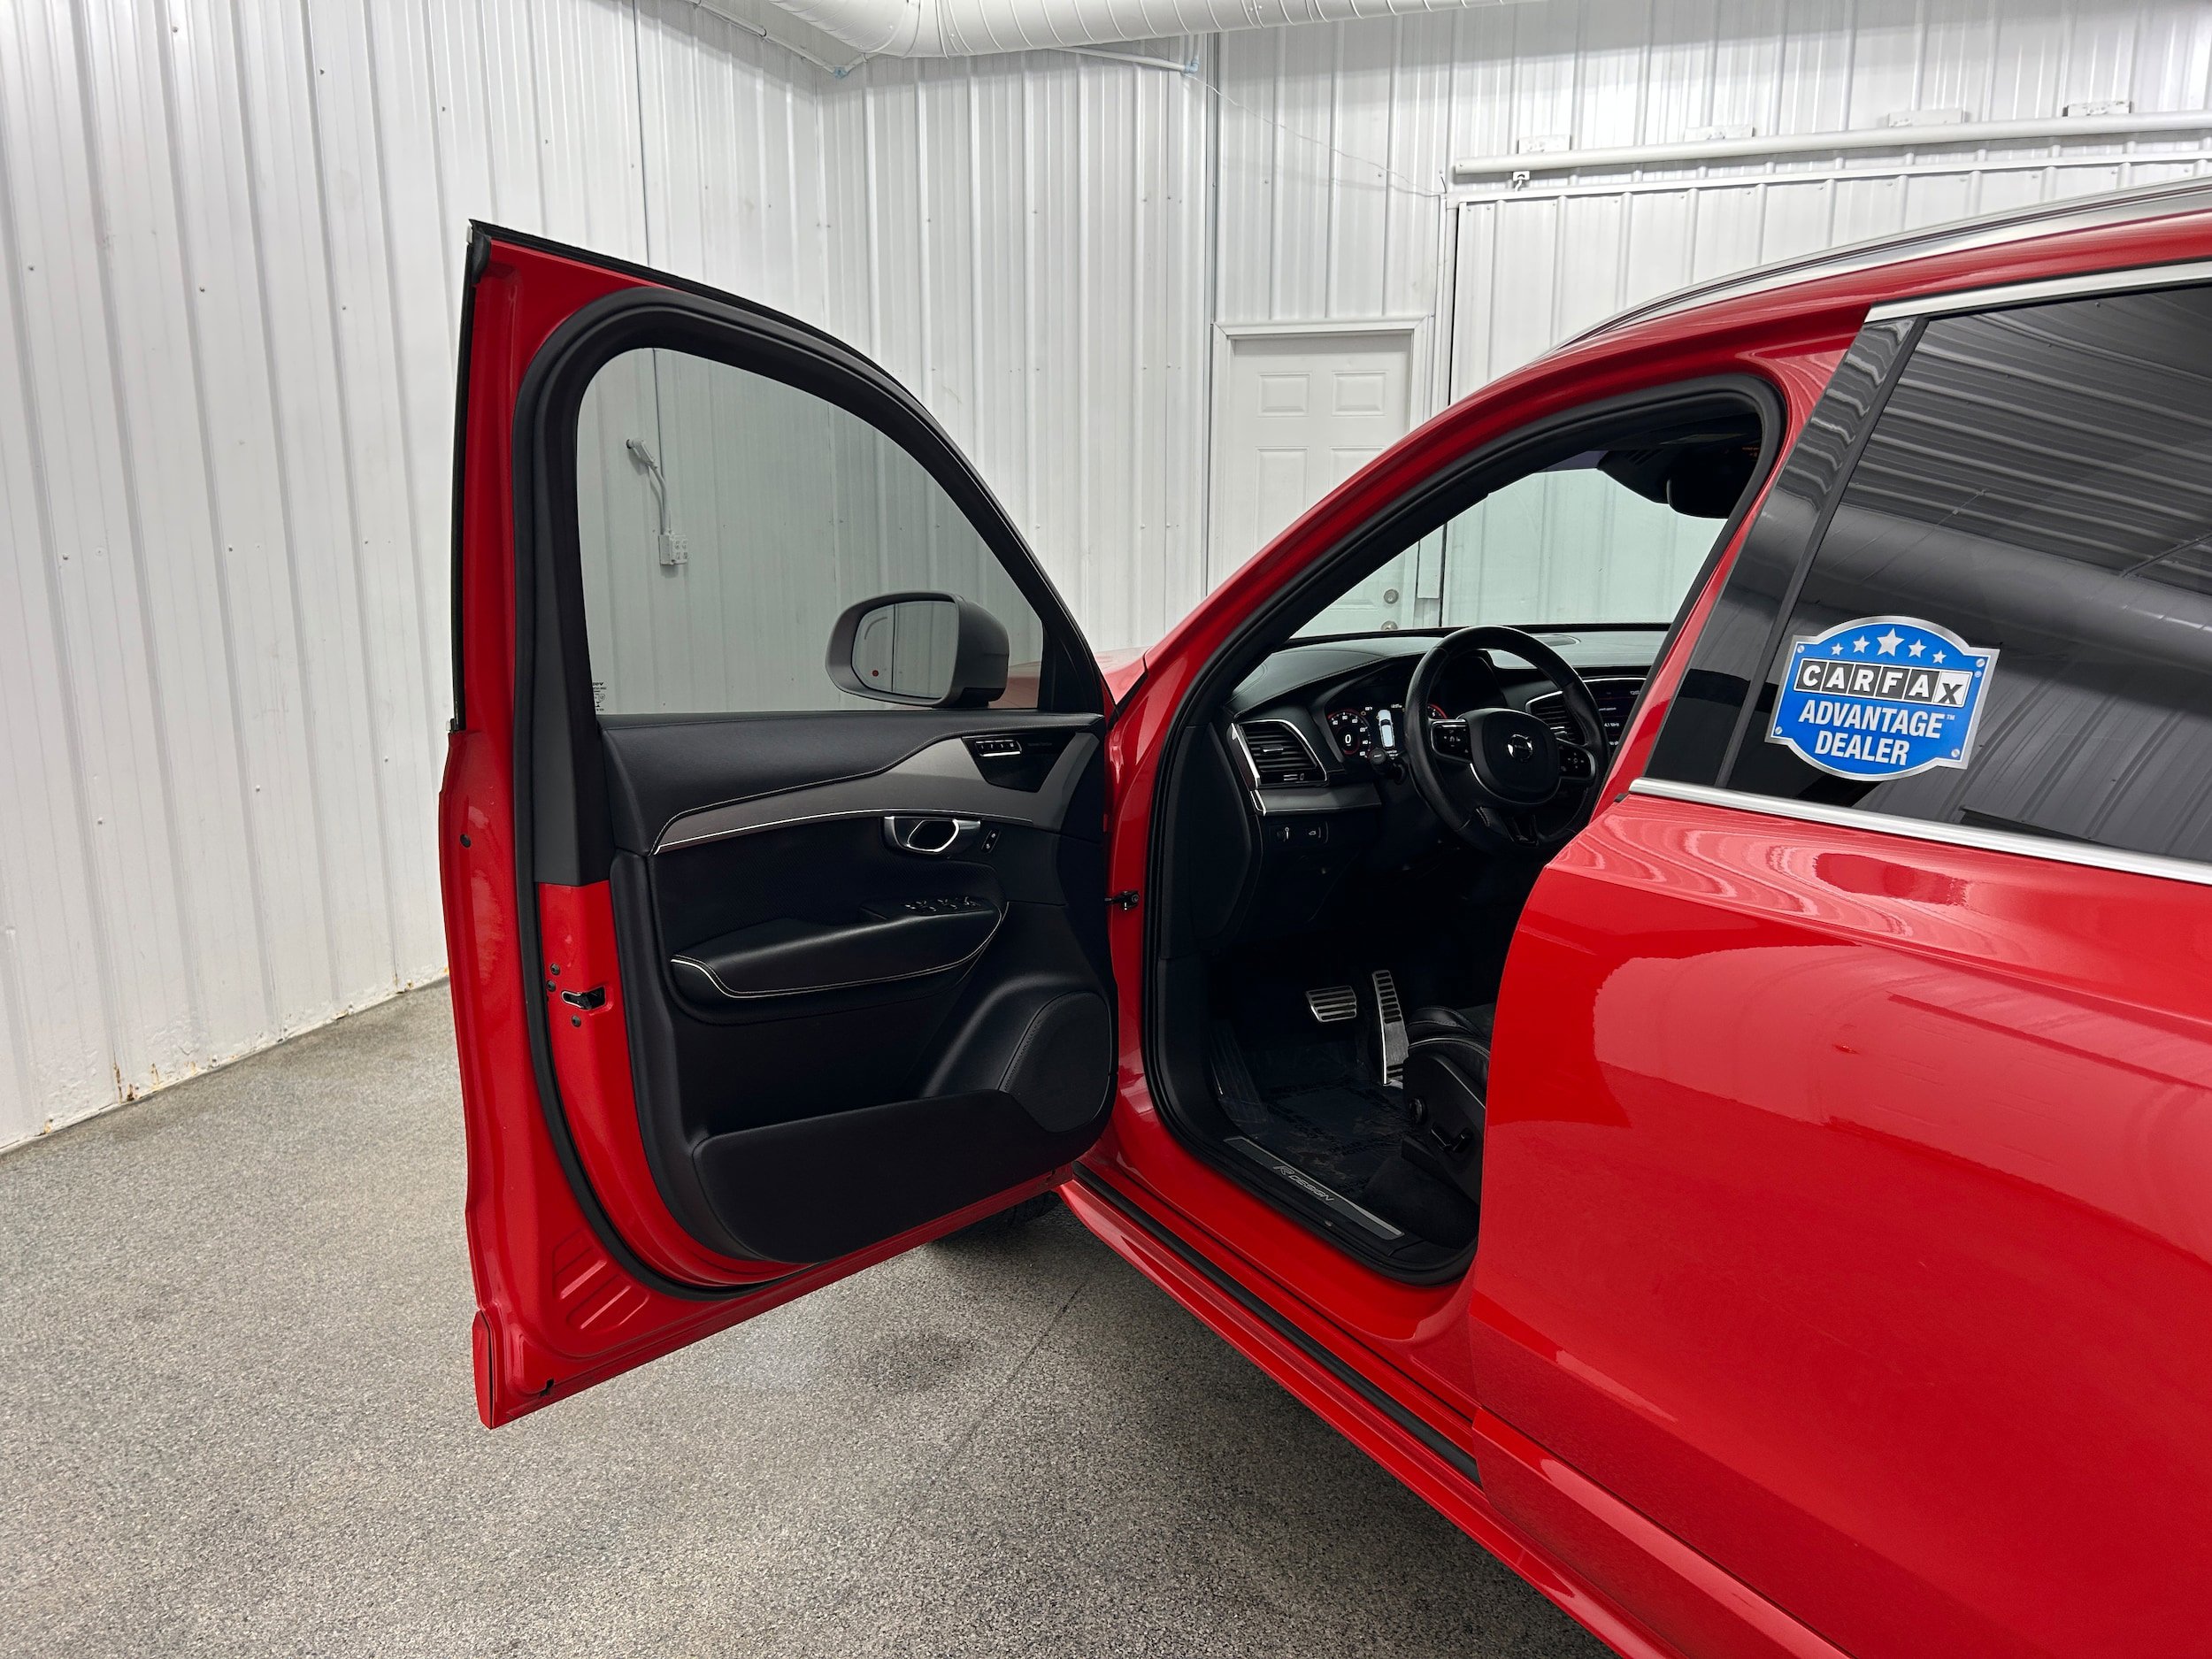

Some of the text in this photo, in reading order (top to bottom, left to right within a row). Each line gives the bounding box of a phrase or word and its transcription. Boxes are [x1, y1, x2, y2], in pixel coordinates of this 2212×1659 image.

[1802, 664, 1964, 705] CARFAX
[1798, 699, 1946, 739] ADVANTAGE
[1345, 734, 1352, 743] 0
[1814, 730, 1910, 766] DEALER
